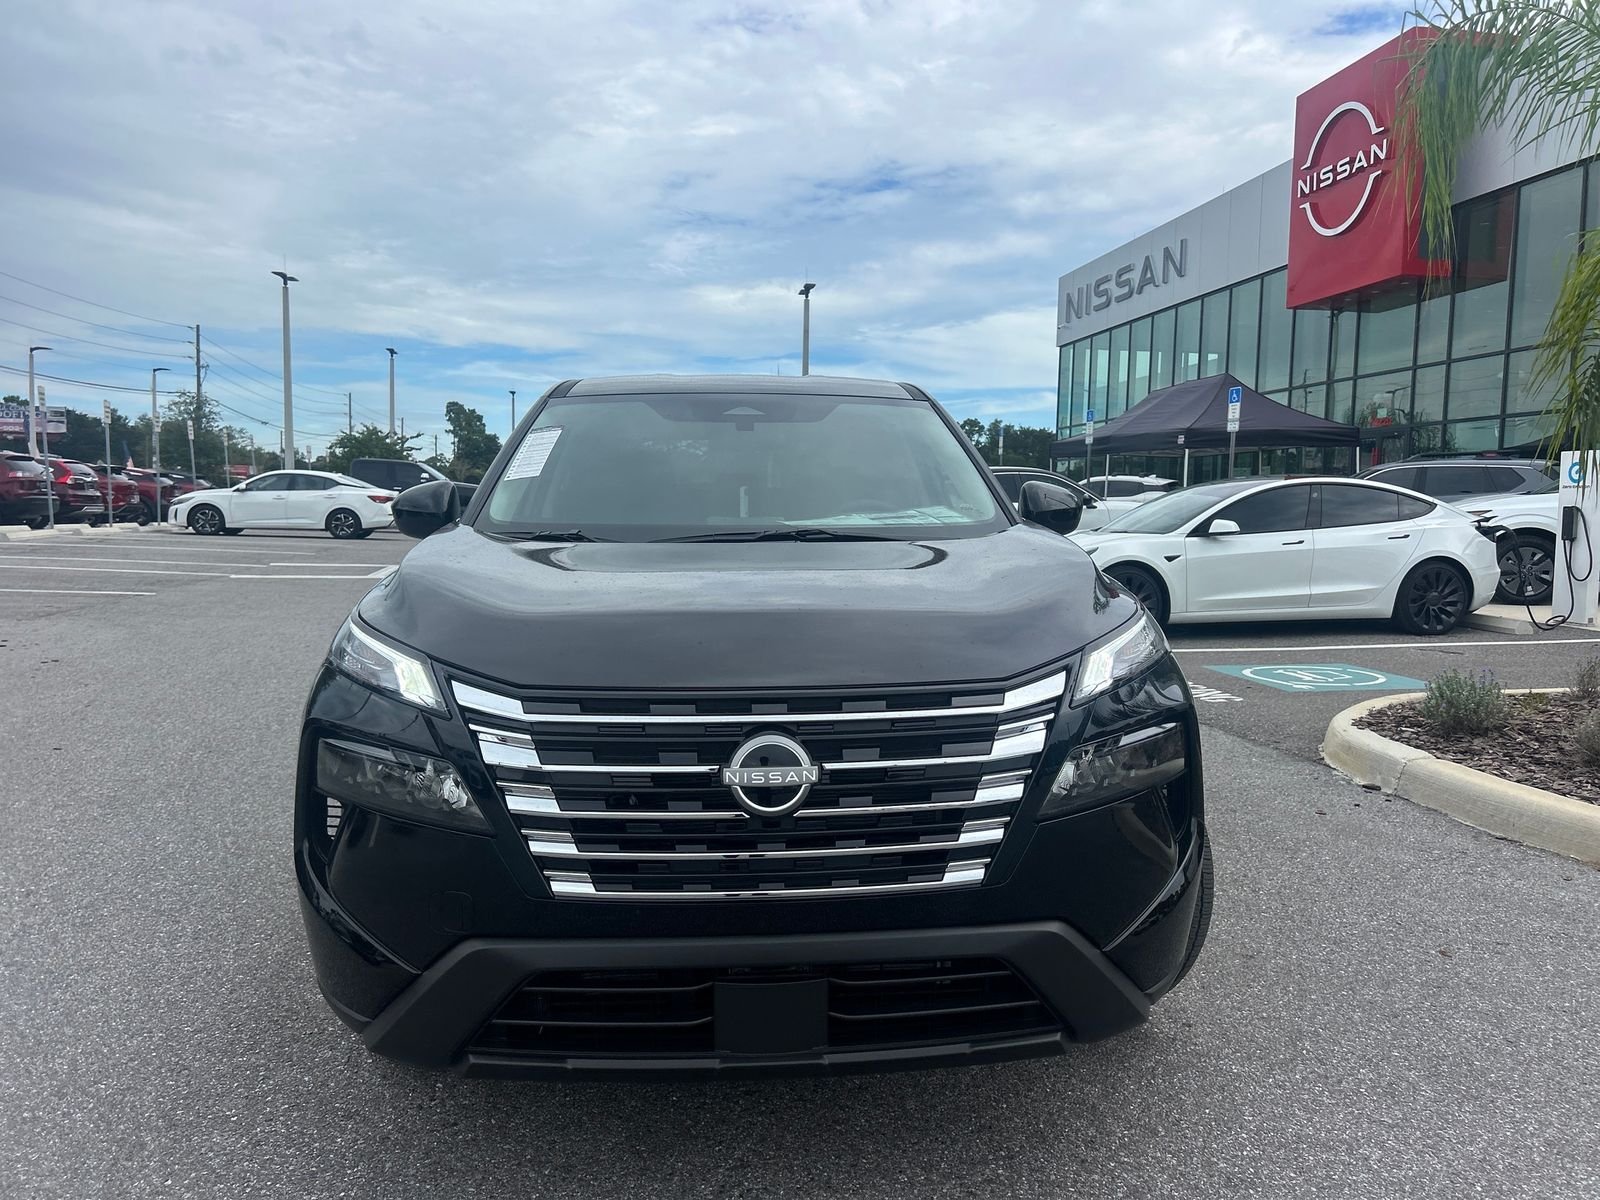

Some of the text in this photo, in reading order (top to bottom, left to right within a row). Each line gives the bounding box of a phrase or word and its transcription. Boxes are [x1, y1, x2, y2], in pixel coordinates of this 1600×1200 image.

[1297, 138, 1387, 198] NISSAN
[1065, 238, 1187, 324] NISSAN
[725, 769, 816, 784] NISSAN
